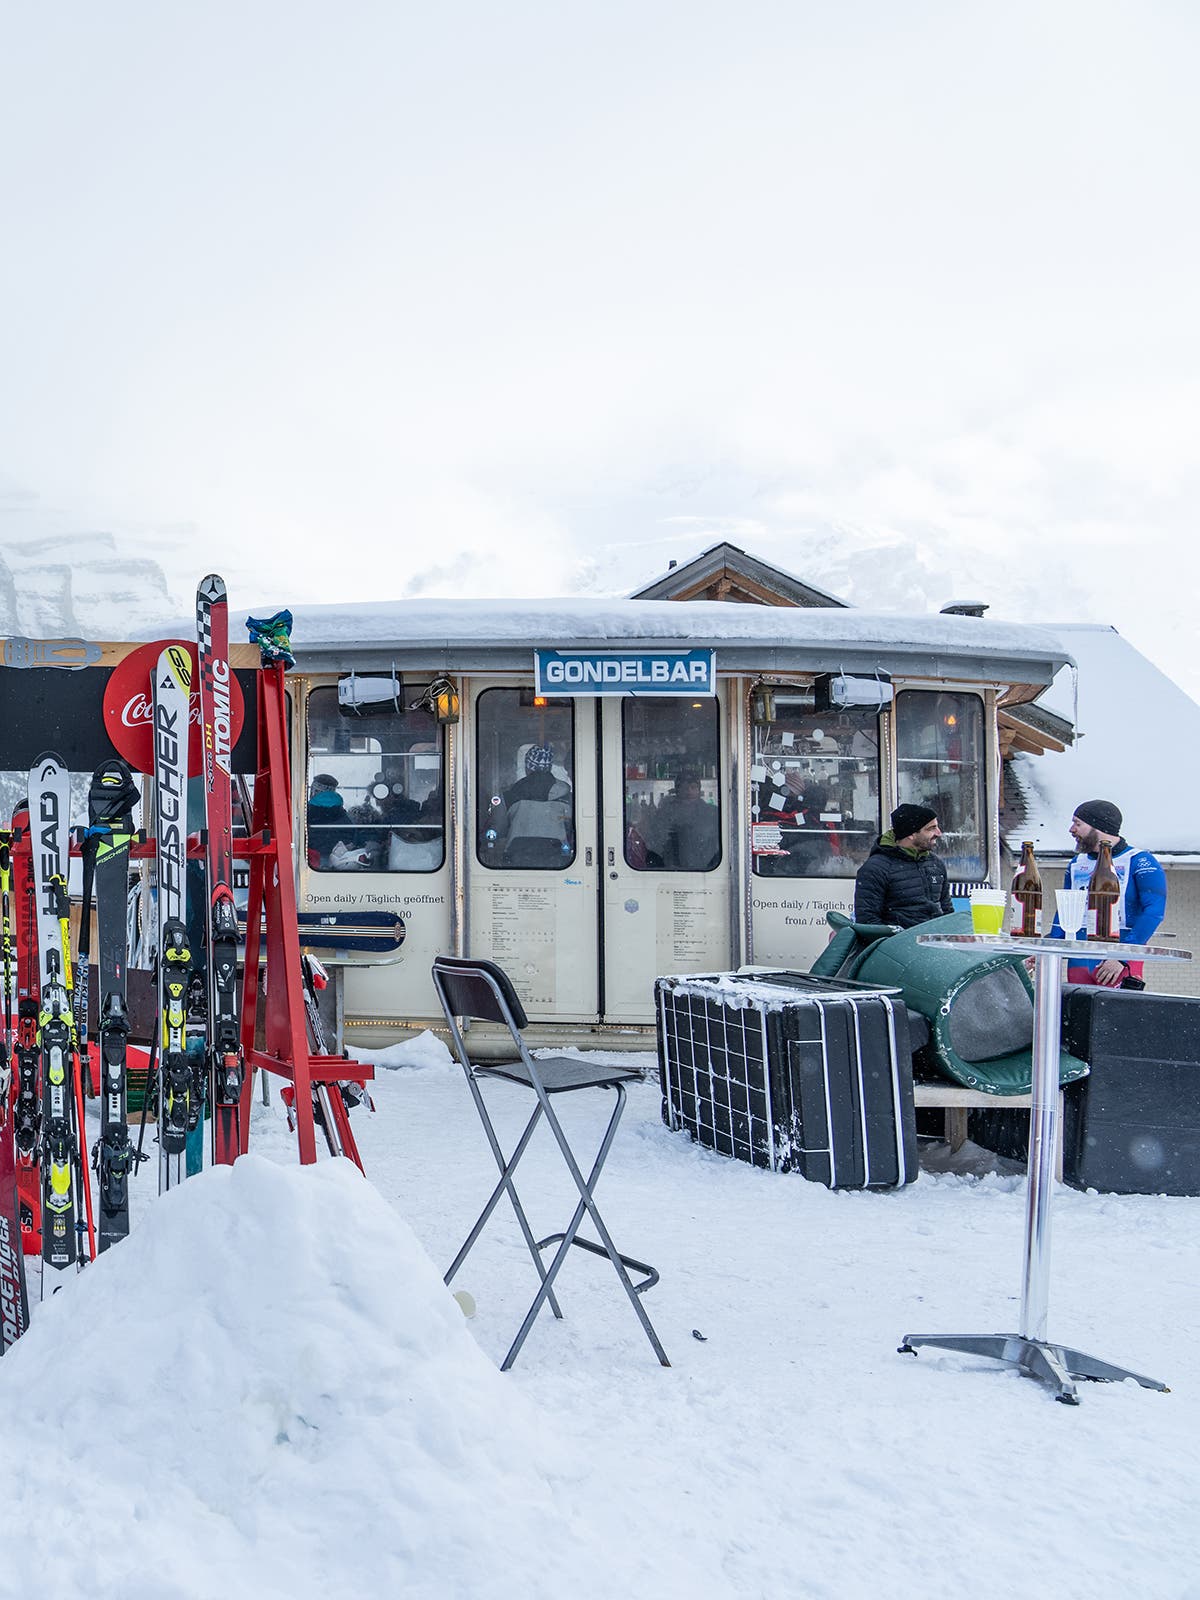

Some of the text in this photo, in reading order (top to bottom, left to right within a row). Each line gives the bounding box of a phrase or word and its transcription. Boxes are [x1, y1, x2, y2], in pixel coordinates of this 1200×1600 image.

[168, 648, 191, 687] GS
[546, 661, 707, 683] GONDELBAR
[212, 659, 231, 775] ATOMIC
[205, 724, 212, 749] DH
[157, 704, 181, 899] FISCHER
[40, 791, 59, 916] HEAD
[96, 844, 129, 866] FISCHER
[306, 893, 445, 906] Open daily / Täglich geöffnet
[752, 898, 778, 910] Open
[780, 899, 804, 911] daily
[805, 899, 810, 909] /
[811, 900, 846, 911] Täglich
[785, 915, 807, 925] from
[815, 917, 827, 926] ab
